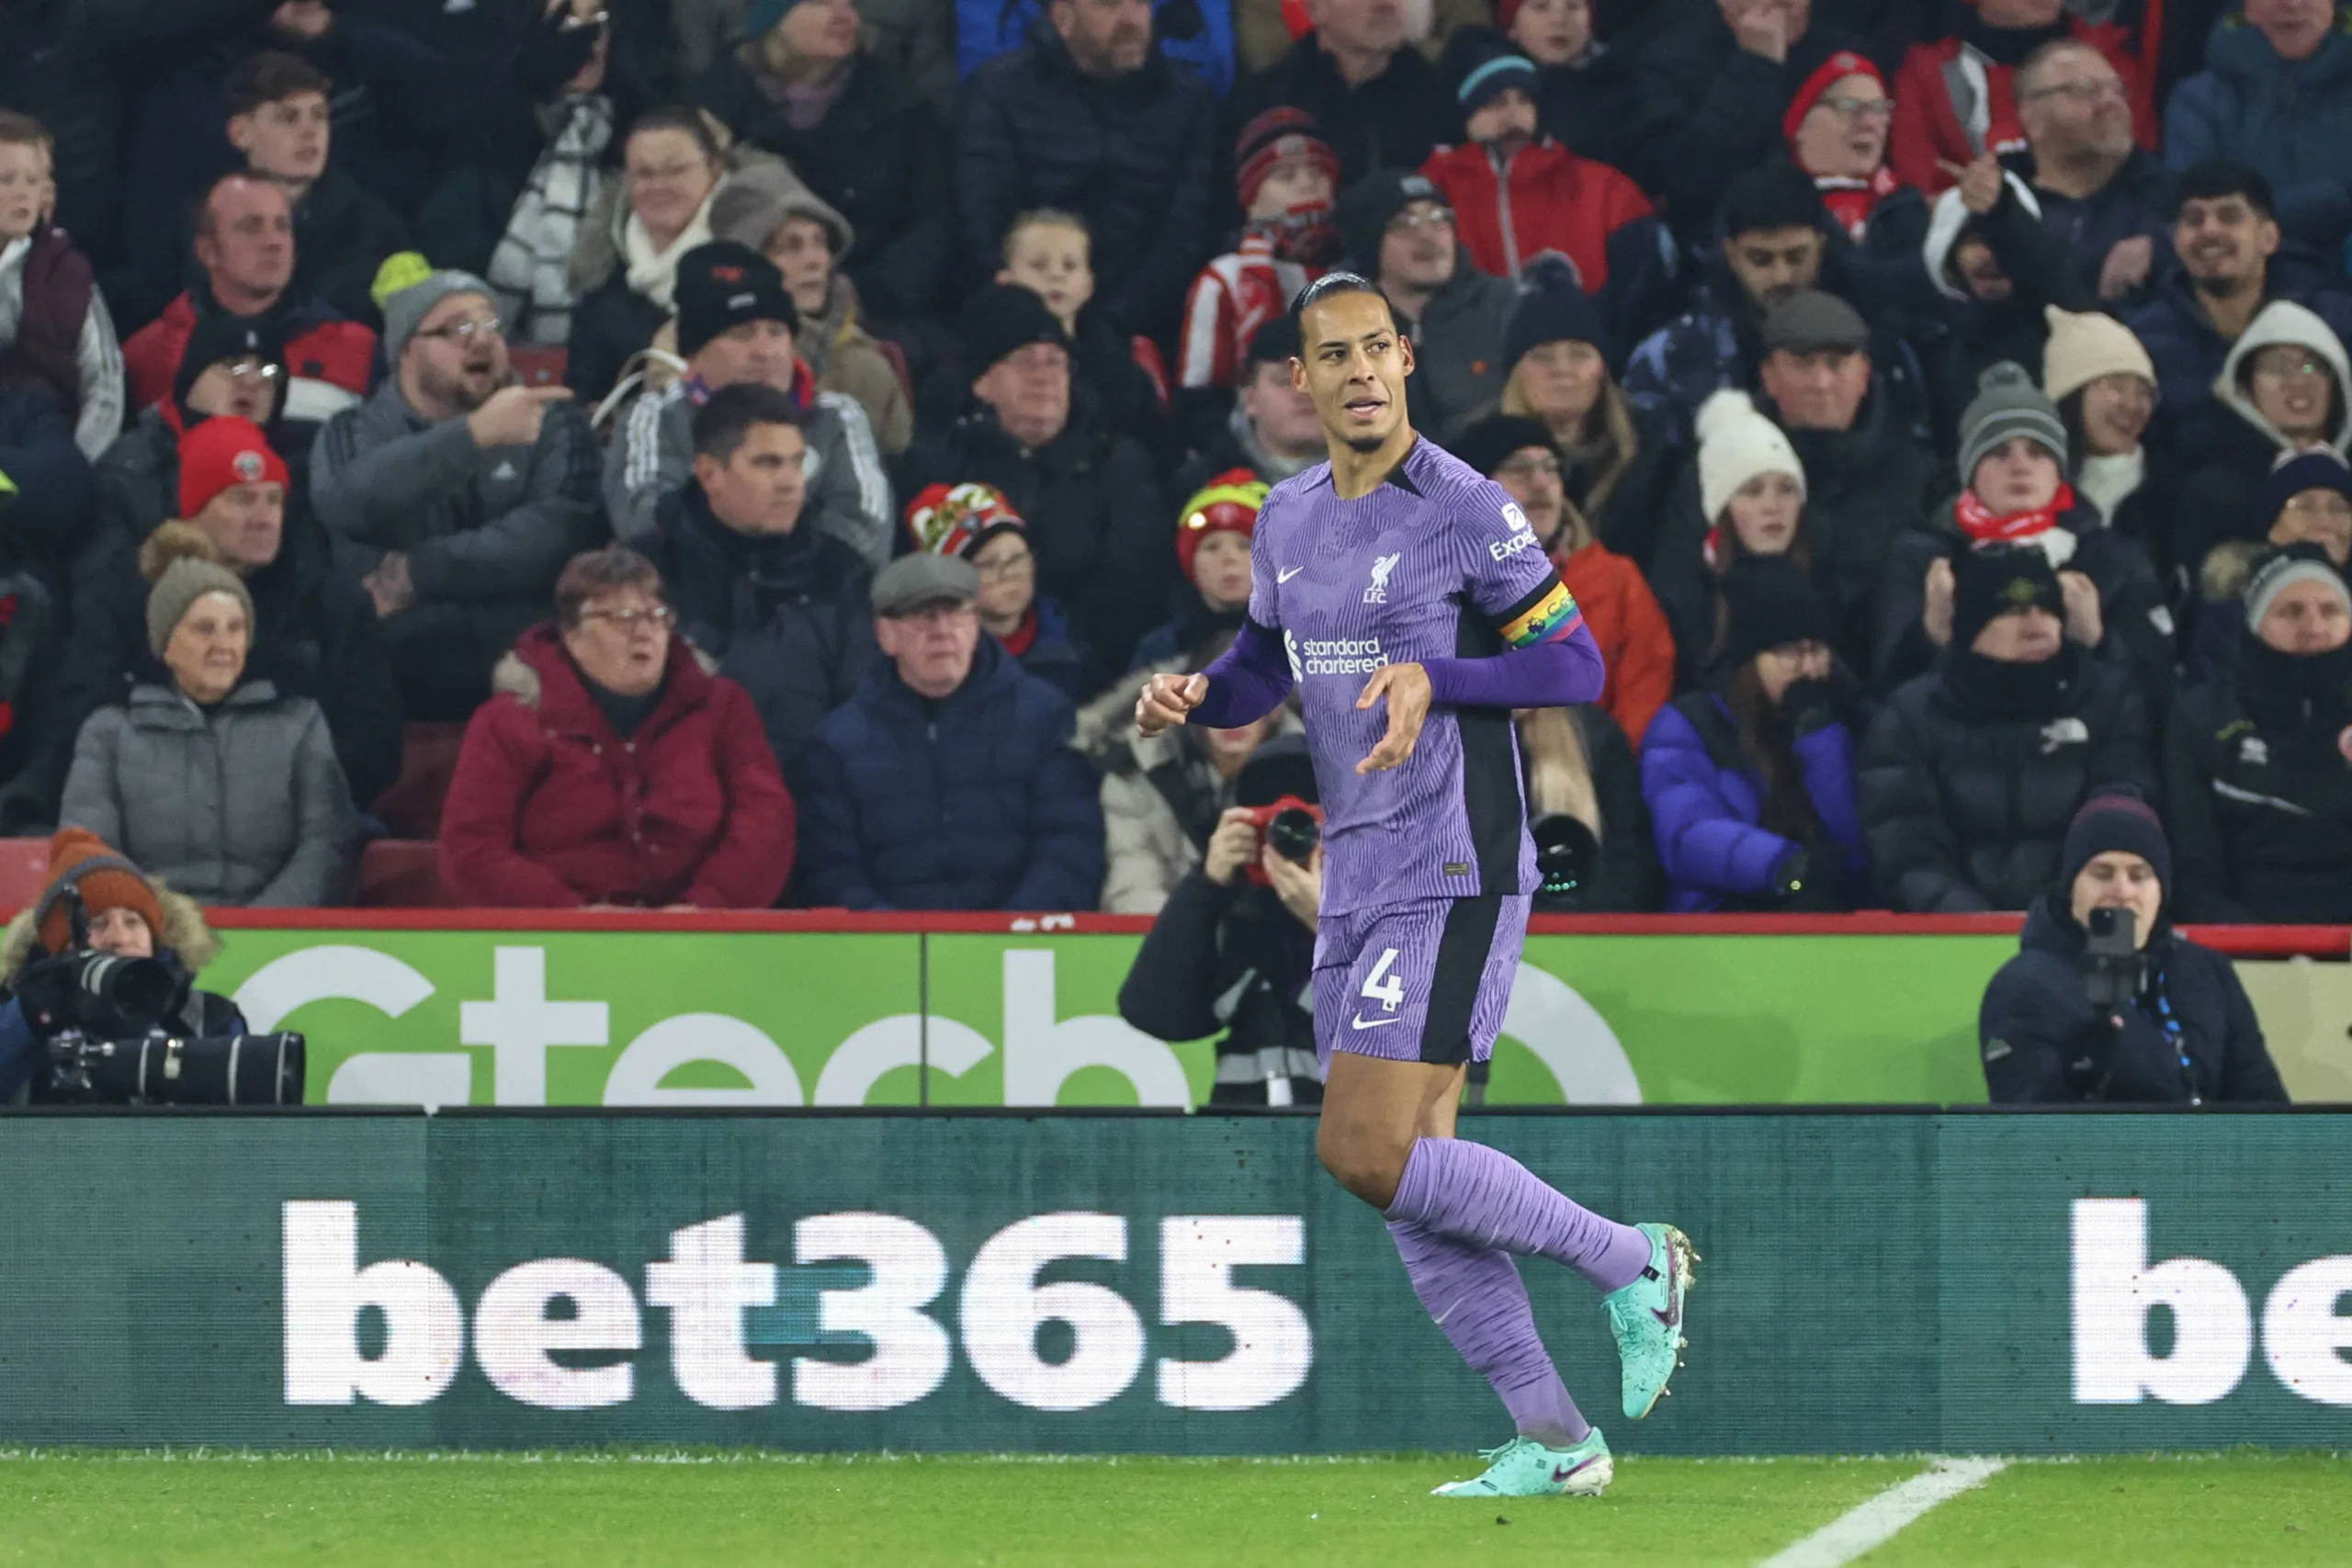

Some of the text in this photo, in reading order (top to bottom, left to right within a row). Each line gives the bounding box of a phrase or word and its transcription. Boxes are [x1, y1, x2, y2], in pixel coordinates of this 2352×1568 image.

[1363, 590, 1387, 604] LFC
[1303, 637, 1380, 656] standard
[1305, 652, 1389, 675] chartered
[1361, 948, 1404, 1012] 4
[283, 1200, 1313, 1412] bet365
